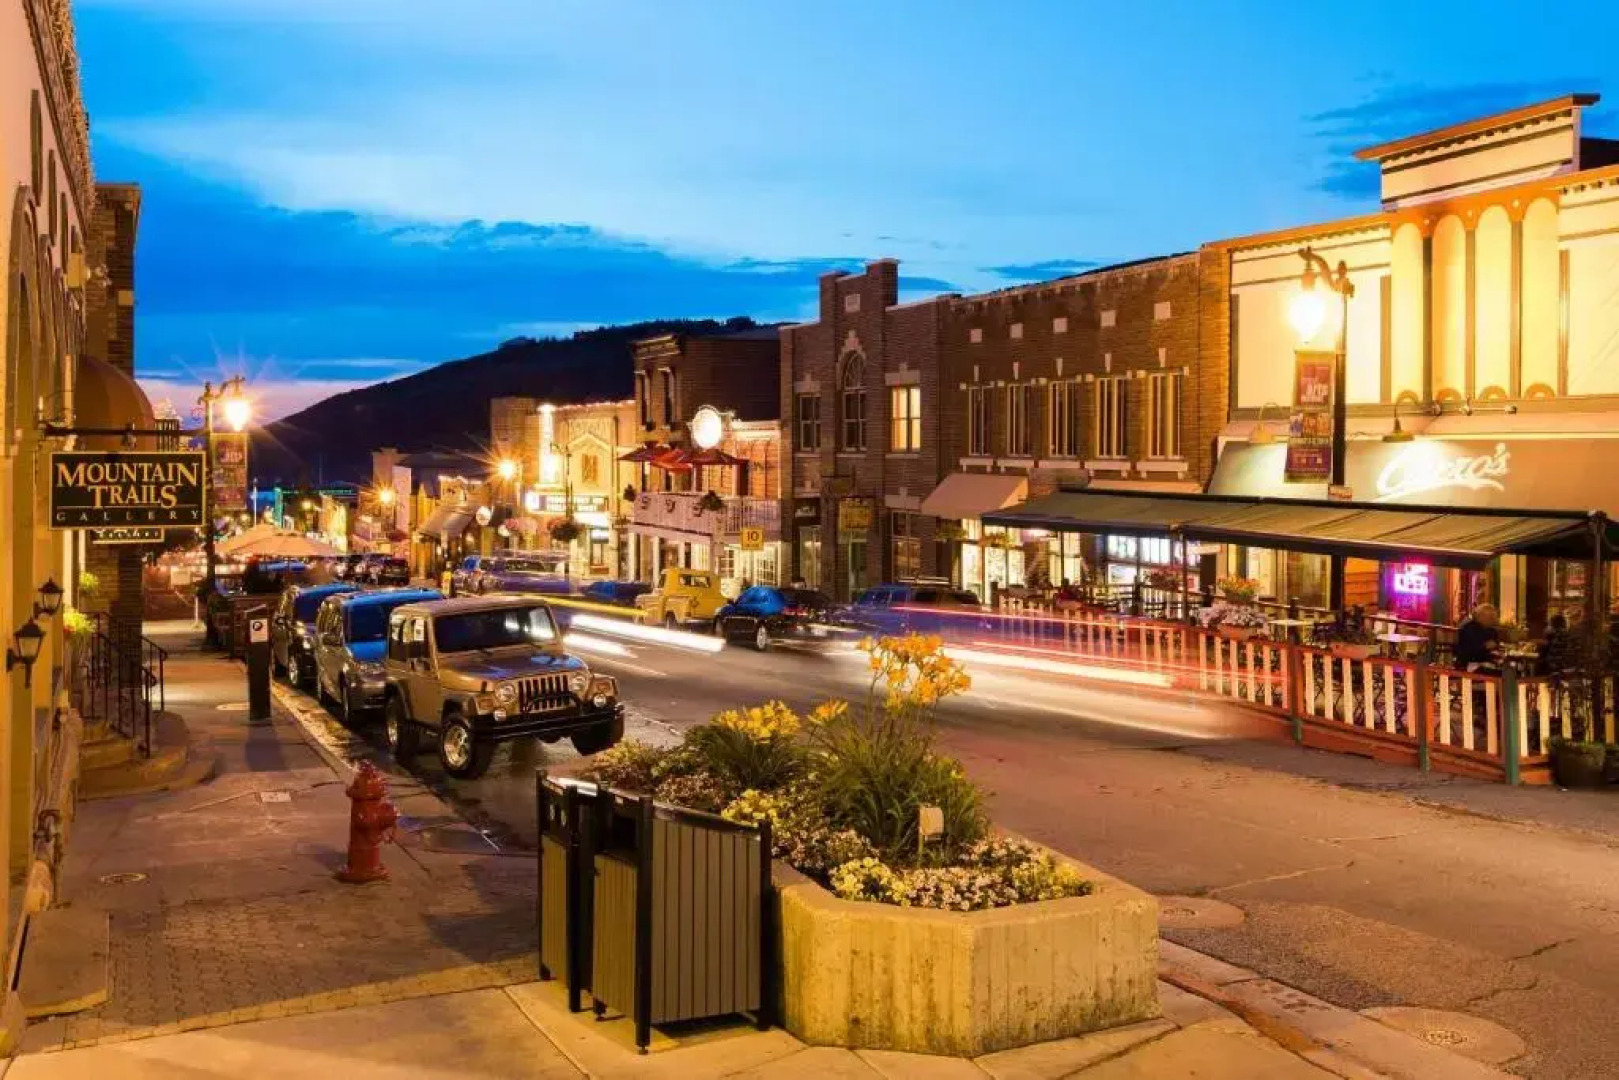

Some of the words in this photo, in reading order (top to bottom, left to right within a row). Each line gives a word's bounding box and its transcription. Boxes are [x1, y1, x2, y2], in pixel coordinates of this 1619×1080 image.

[56, 462, 200, 487] MOUNTAIN
[87, 484, 178, 509] TRAILS
[56, 510, 199, 521] GALLERY
